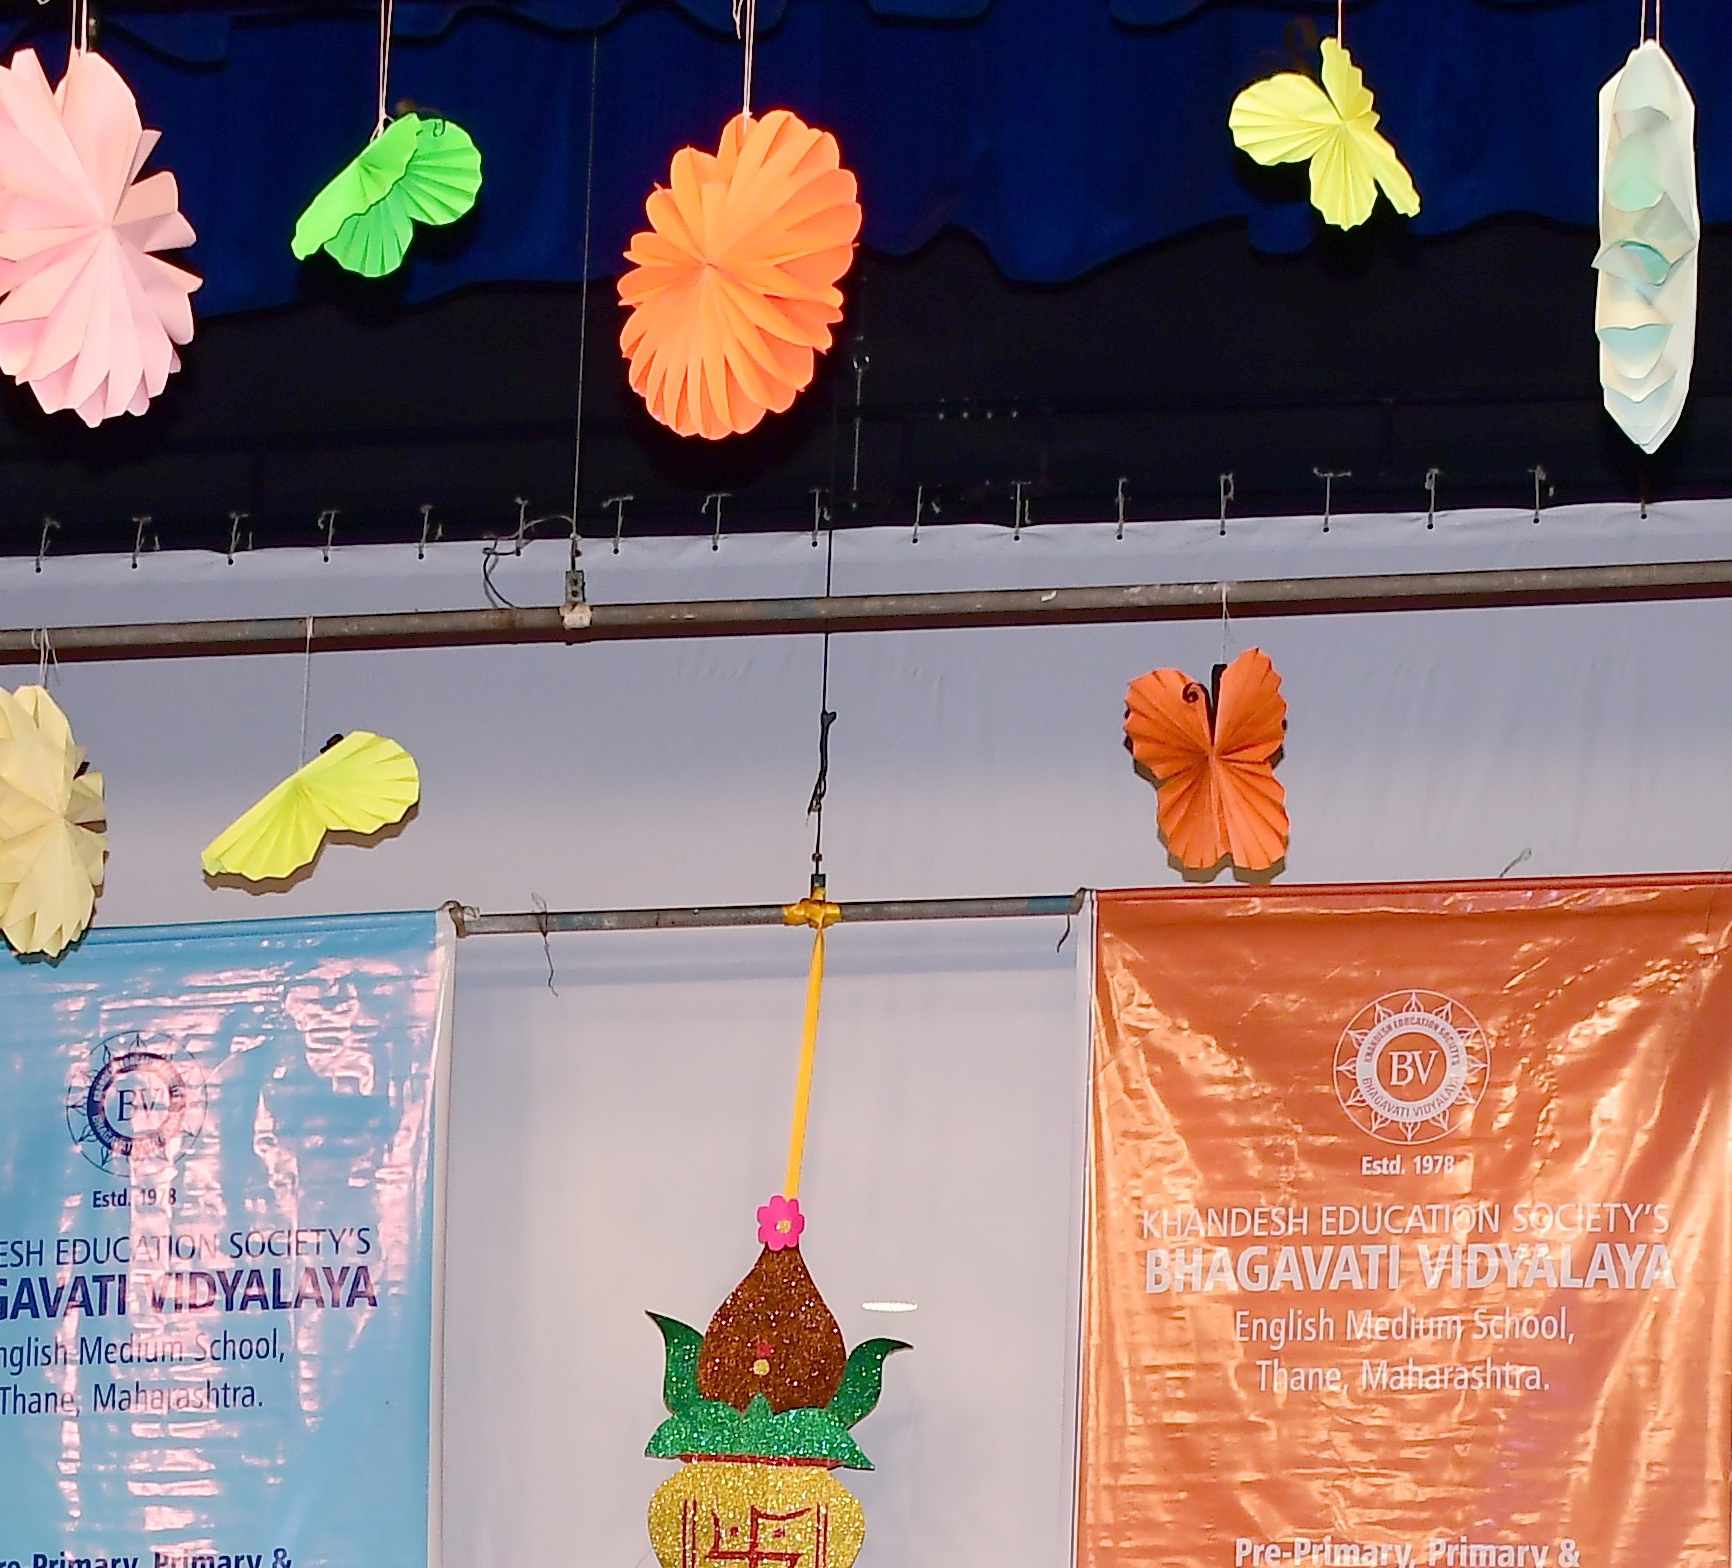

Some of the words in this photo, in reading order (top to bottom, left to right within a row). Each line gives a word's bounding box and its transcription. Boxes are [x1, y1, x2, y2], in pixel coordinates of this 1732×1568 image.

[1388, 1050, 1439, 1086] BV
[1361, 1154, 1405, 1175] Estd.
[1413, 1154, 1455, 1175] 1978
[92, 1188, 132, 1208] Estd.
[1142, 1206, 1309, 1239] KHANDESH
[1321, 1203, 1499, 1236] EDUCATION
[1512, 1202, 1669, 1235] SOCIETY'S
[56, 1233, 218, 1266] EDUCATION
[229, 1228, 371, 1259] SOCIETY'S
[1145, 1244, 1400, 1293] BHAGAVATI
[1418, 1242, 1676, 1290] VIDYALAYA
[146, 1266, 378, 1314] VIDYALAYA
[79, 1333, 183, 1365] Medium
[194, 1328, 284, 1363] School,
[1234, 1308, 1335, 1351] English
[1346, 1307, 1462, 1341] Medium
[1472, 1306, 1575, 1345] School,
[1256, 1356, 1349, 1395] Thane,
[1362, 1357, 1550, 1392] Maharashtra.
[93, 1379, 263, 1412] Maharashtra.
[1557, 1538, 1580, 1568] &
